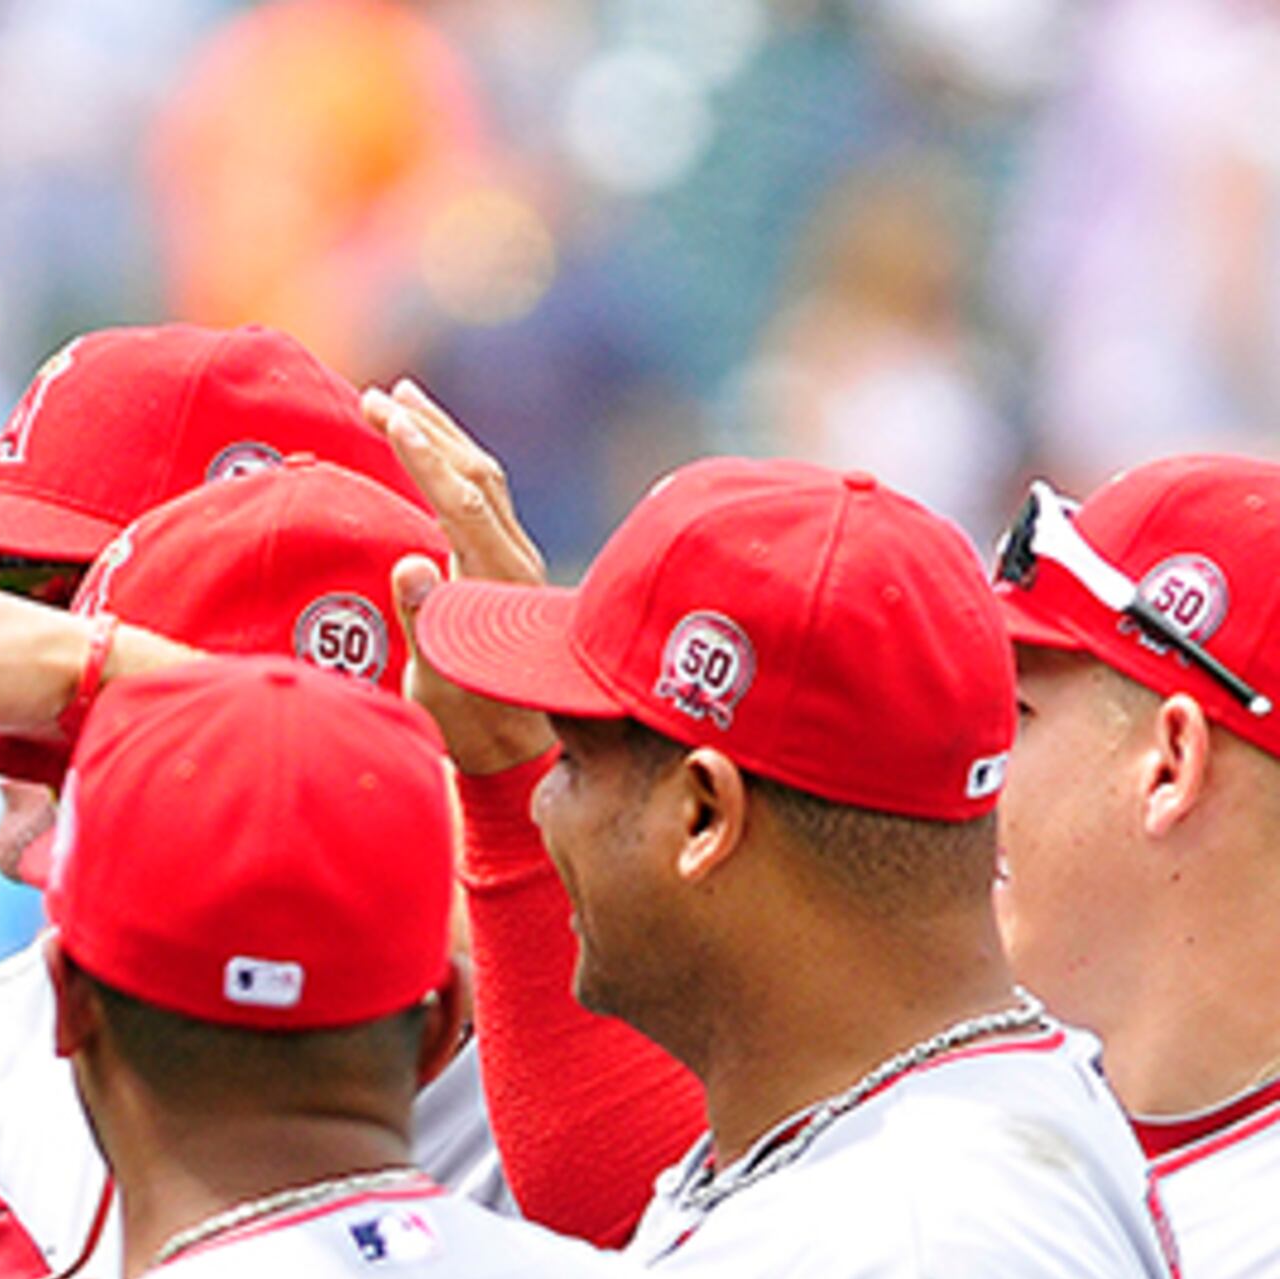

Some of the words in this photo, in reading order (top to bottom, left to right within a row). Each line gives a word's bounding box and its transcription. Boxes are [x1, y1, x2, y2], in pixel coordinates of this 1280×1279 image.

[1151, 576, 1204, 626] 50
[318, 621, 368, 666] 50
[681, 637, 732, 688] 50
